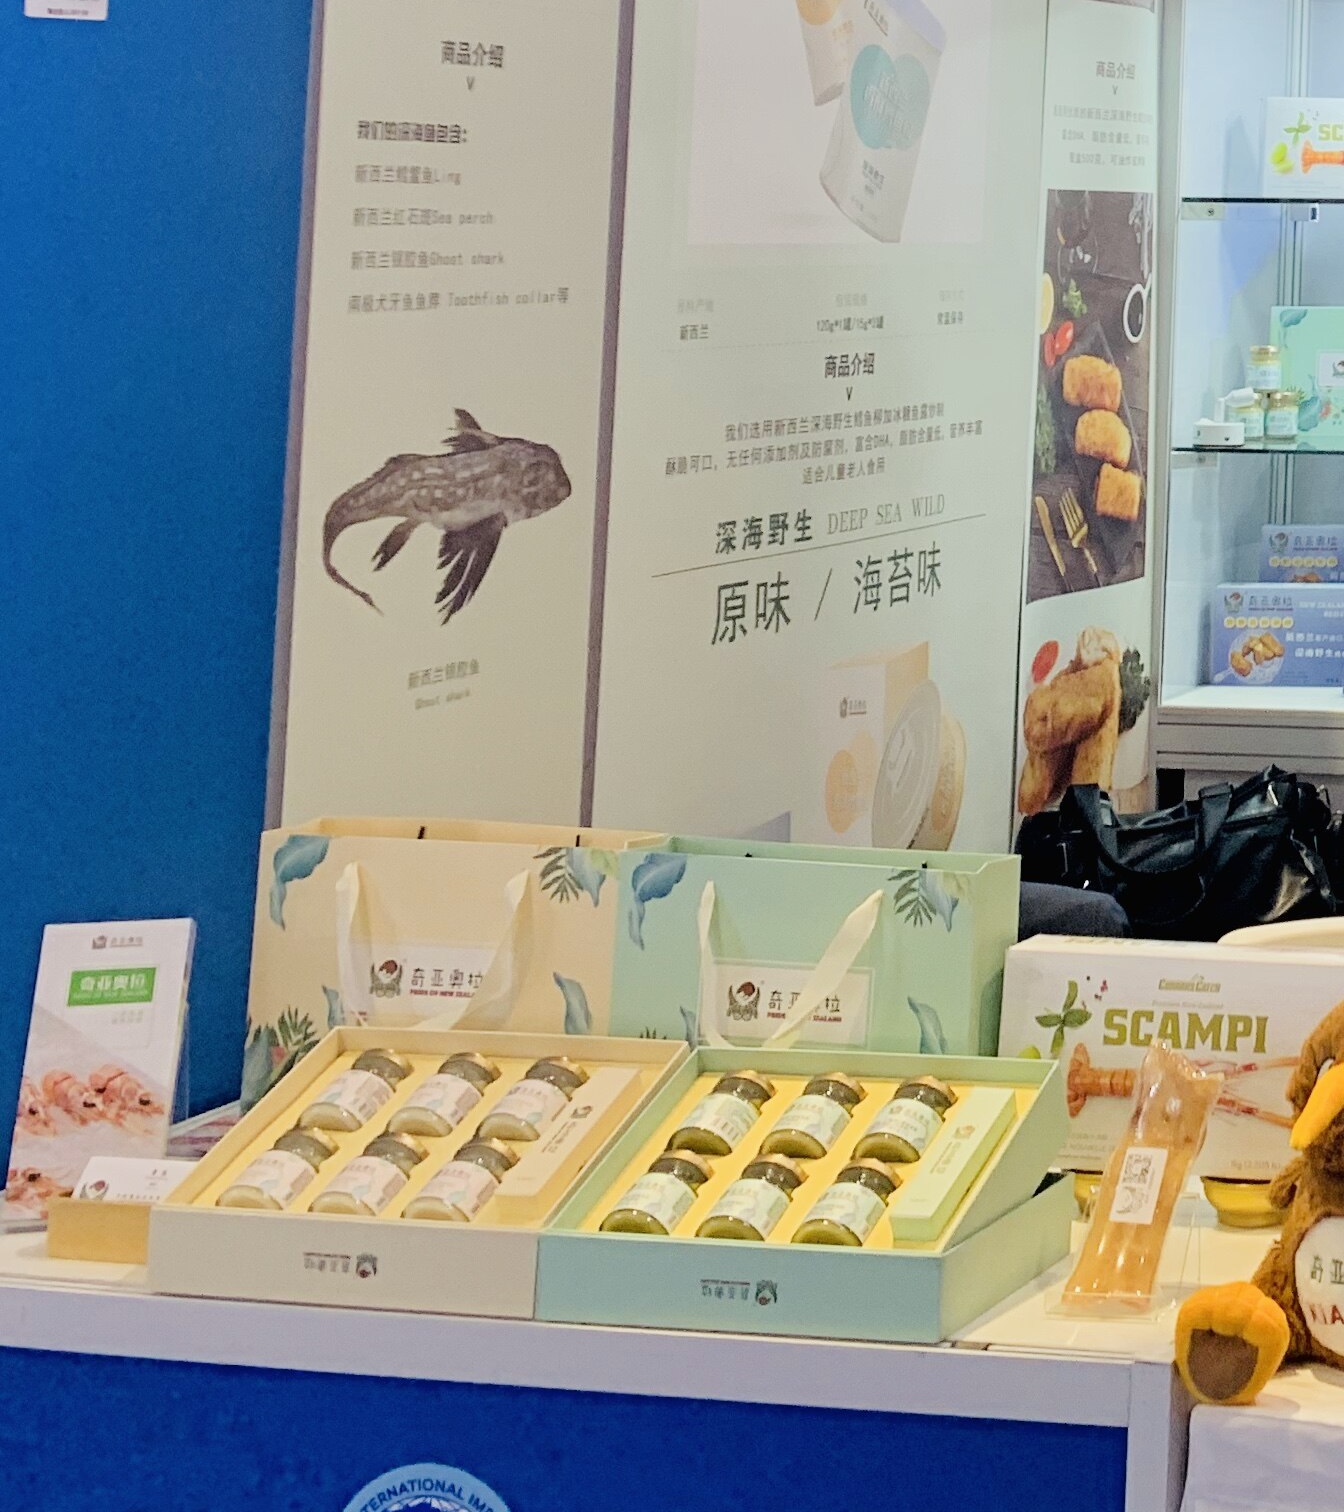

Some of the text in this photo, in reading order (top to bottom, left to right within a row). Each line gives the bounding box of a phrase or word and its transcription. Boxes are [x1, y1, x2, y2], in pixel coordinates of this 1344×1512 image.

[440, 39, 505, 69] 商品介绍
[823, 352, 876, 380] 商品介绍
[715, 493, 946, 556] 深海野生 DEEP SEA WILD
[710, 570, 792, 647] 原味
[853, 540, 944, 616] 海苔味
[411, 967, 483, 989] 奇亚奥拉
[1102, 1008, 1269, 1054] SCAMPI
